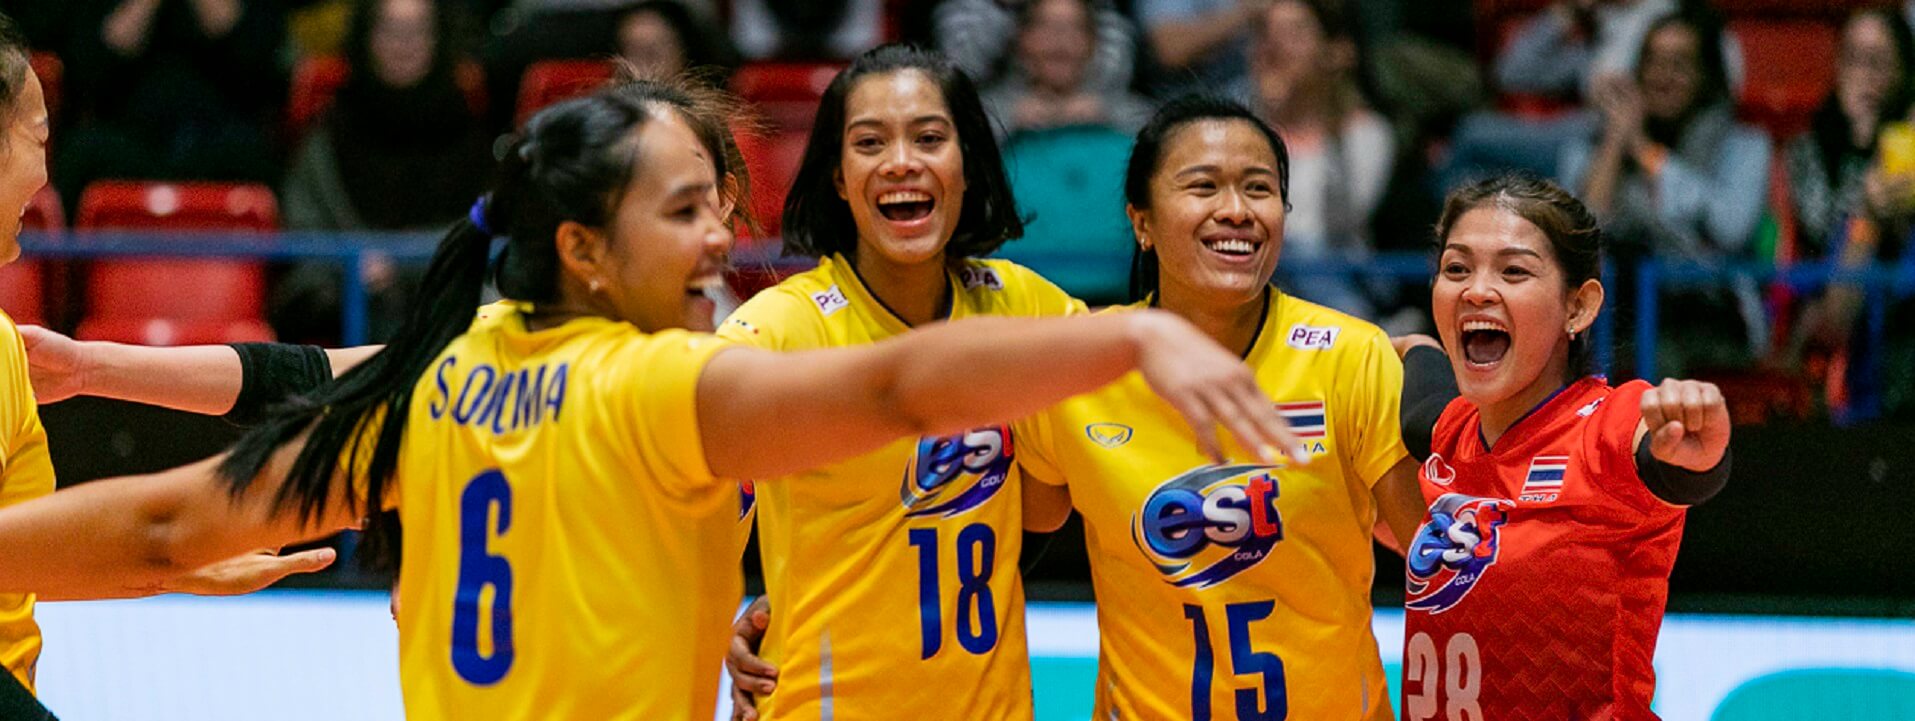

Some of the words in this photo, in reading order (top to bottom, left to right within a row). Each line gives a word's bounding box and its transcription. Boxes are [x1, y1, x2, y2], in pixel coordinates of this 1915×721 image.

[1291, 327, 1331, 345] PEA
[1142, 473, 1282, 558] est
[1234, 550, 1263, 561] COLA
[451, 469, 514, 686] 6
[908, 522, 998, 661] 18
[1183, 600, 1288, 721] 15
[1407, 631, 1484, 721] 28
